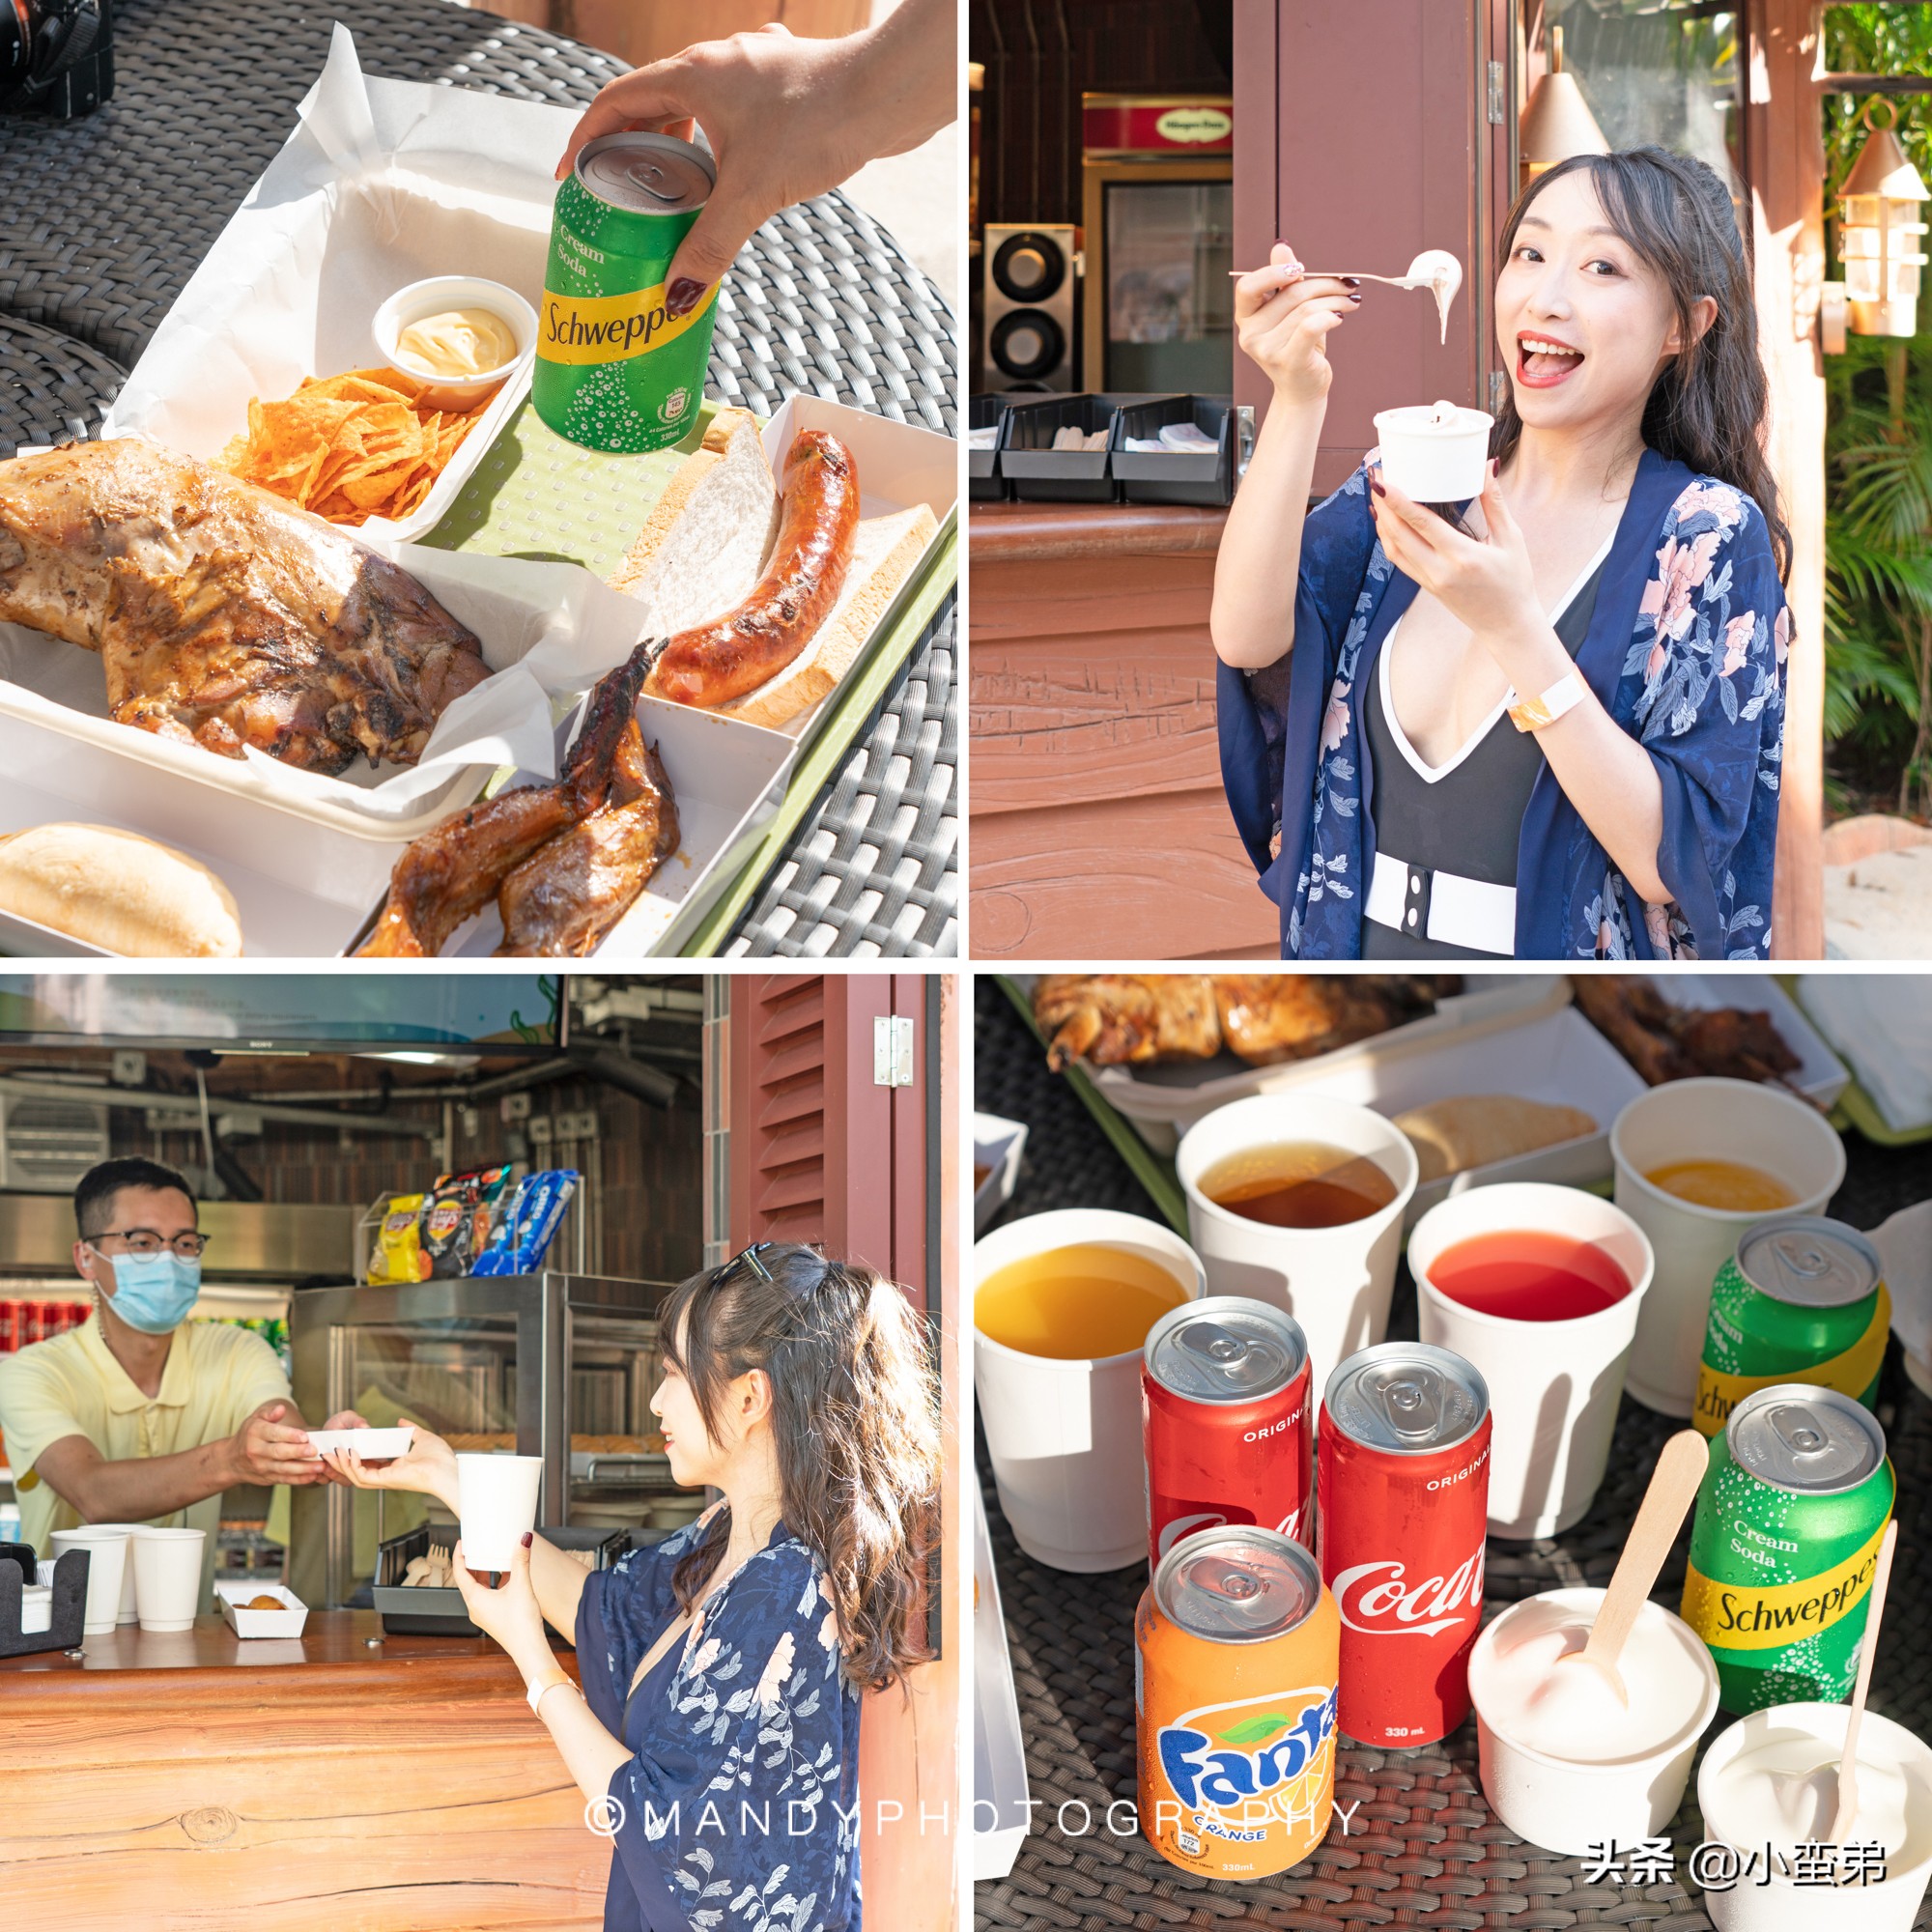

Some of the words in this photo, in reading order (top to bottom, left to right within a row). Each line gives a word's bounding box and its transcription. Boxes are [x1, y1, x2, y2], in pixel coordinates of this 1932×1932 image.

[560, 223, 605, 265] Cream
[557, 246, 587, 278] Soda
[547, 301, 679, 351] Schwepp
[1733, 1520, 1799, 1553] Cream
[1730, 1538, 1776, 1569] Soda
[1718, 1545, 1880, 1632] Schweppes
[1159, 1684, 1338, 1811] Fanta
[1385, 1727, 1408, 1737] 330
[1194, 1815, 1265, 1841] ORANGE
